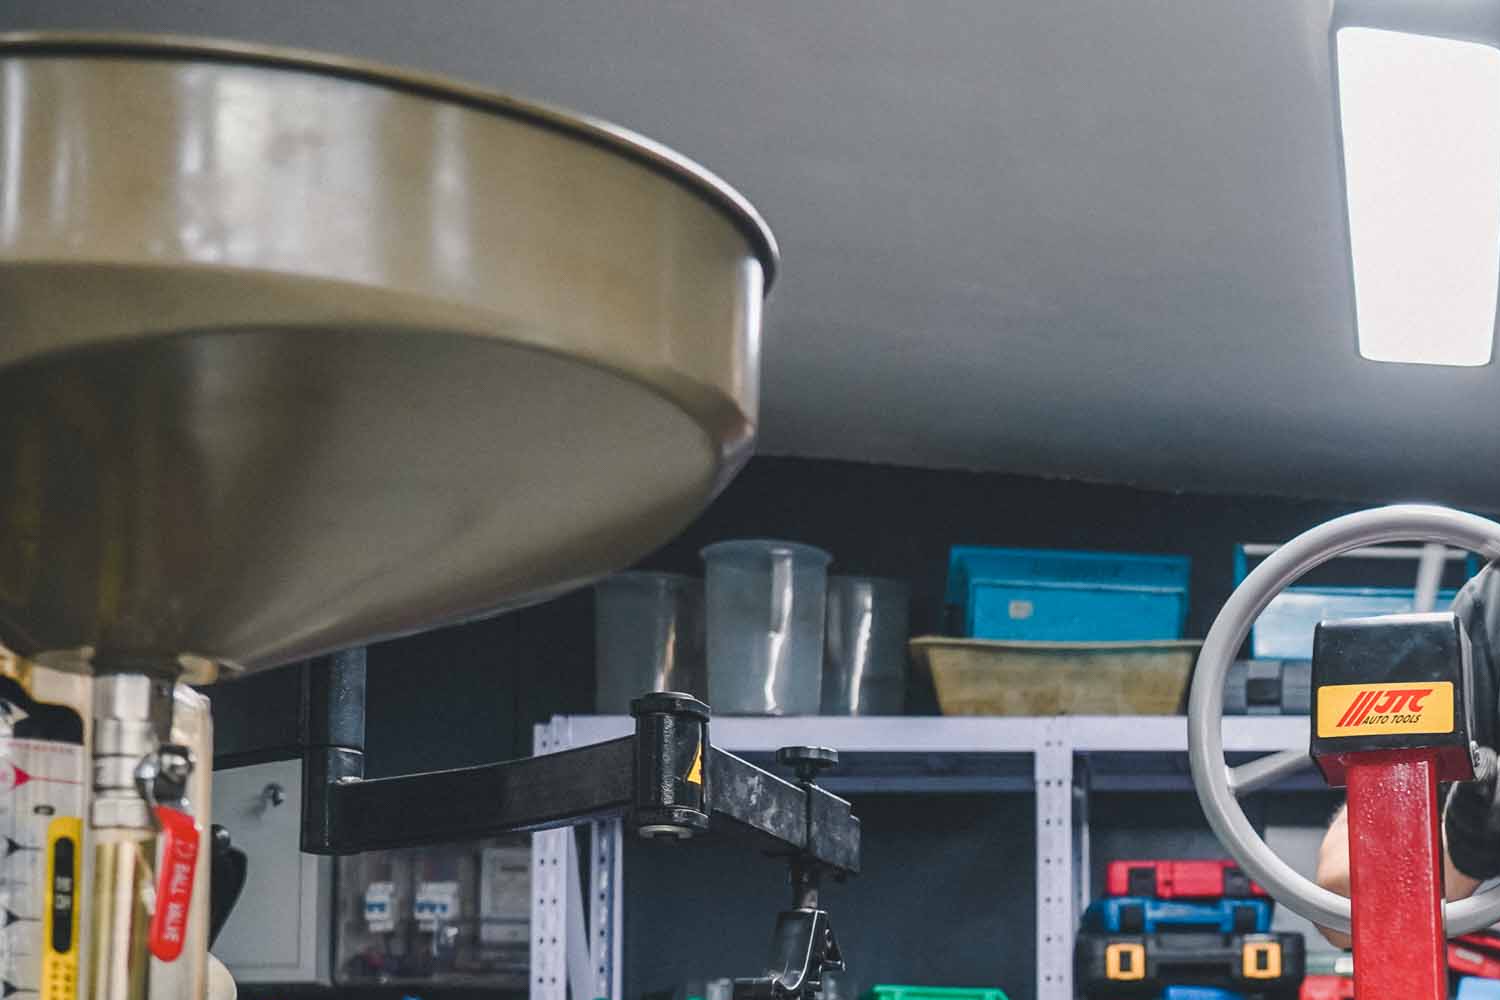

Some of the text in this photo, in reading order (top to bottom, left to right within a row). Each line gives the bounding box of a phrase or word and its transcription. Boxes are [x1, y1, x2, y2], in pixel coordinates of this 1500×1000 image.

[1374, 689, 1433, 713] JTC
[1362, 714, 1421, 725] AUTO TOOLS
